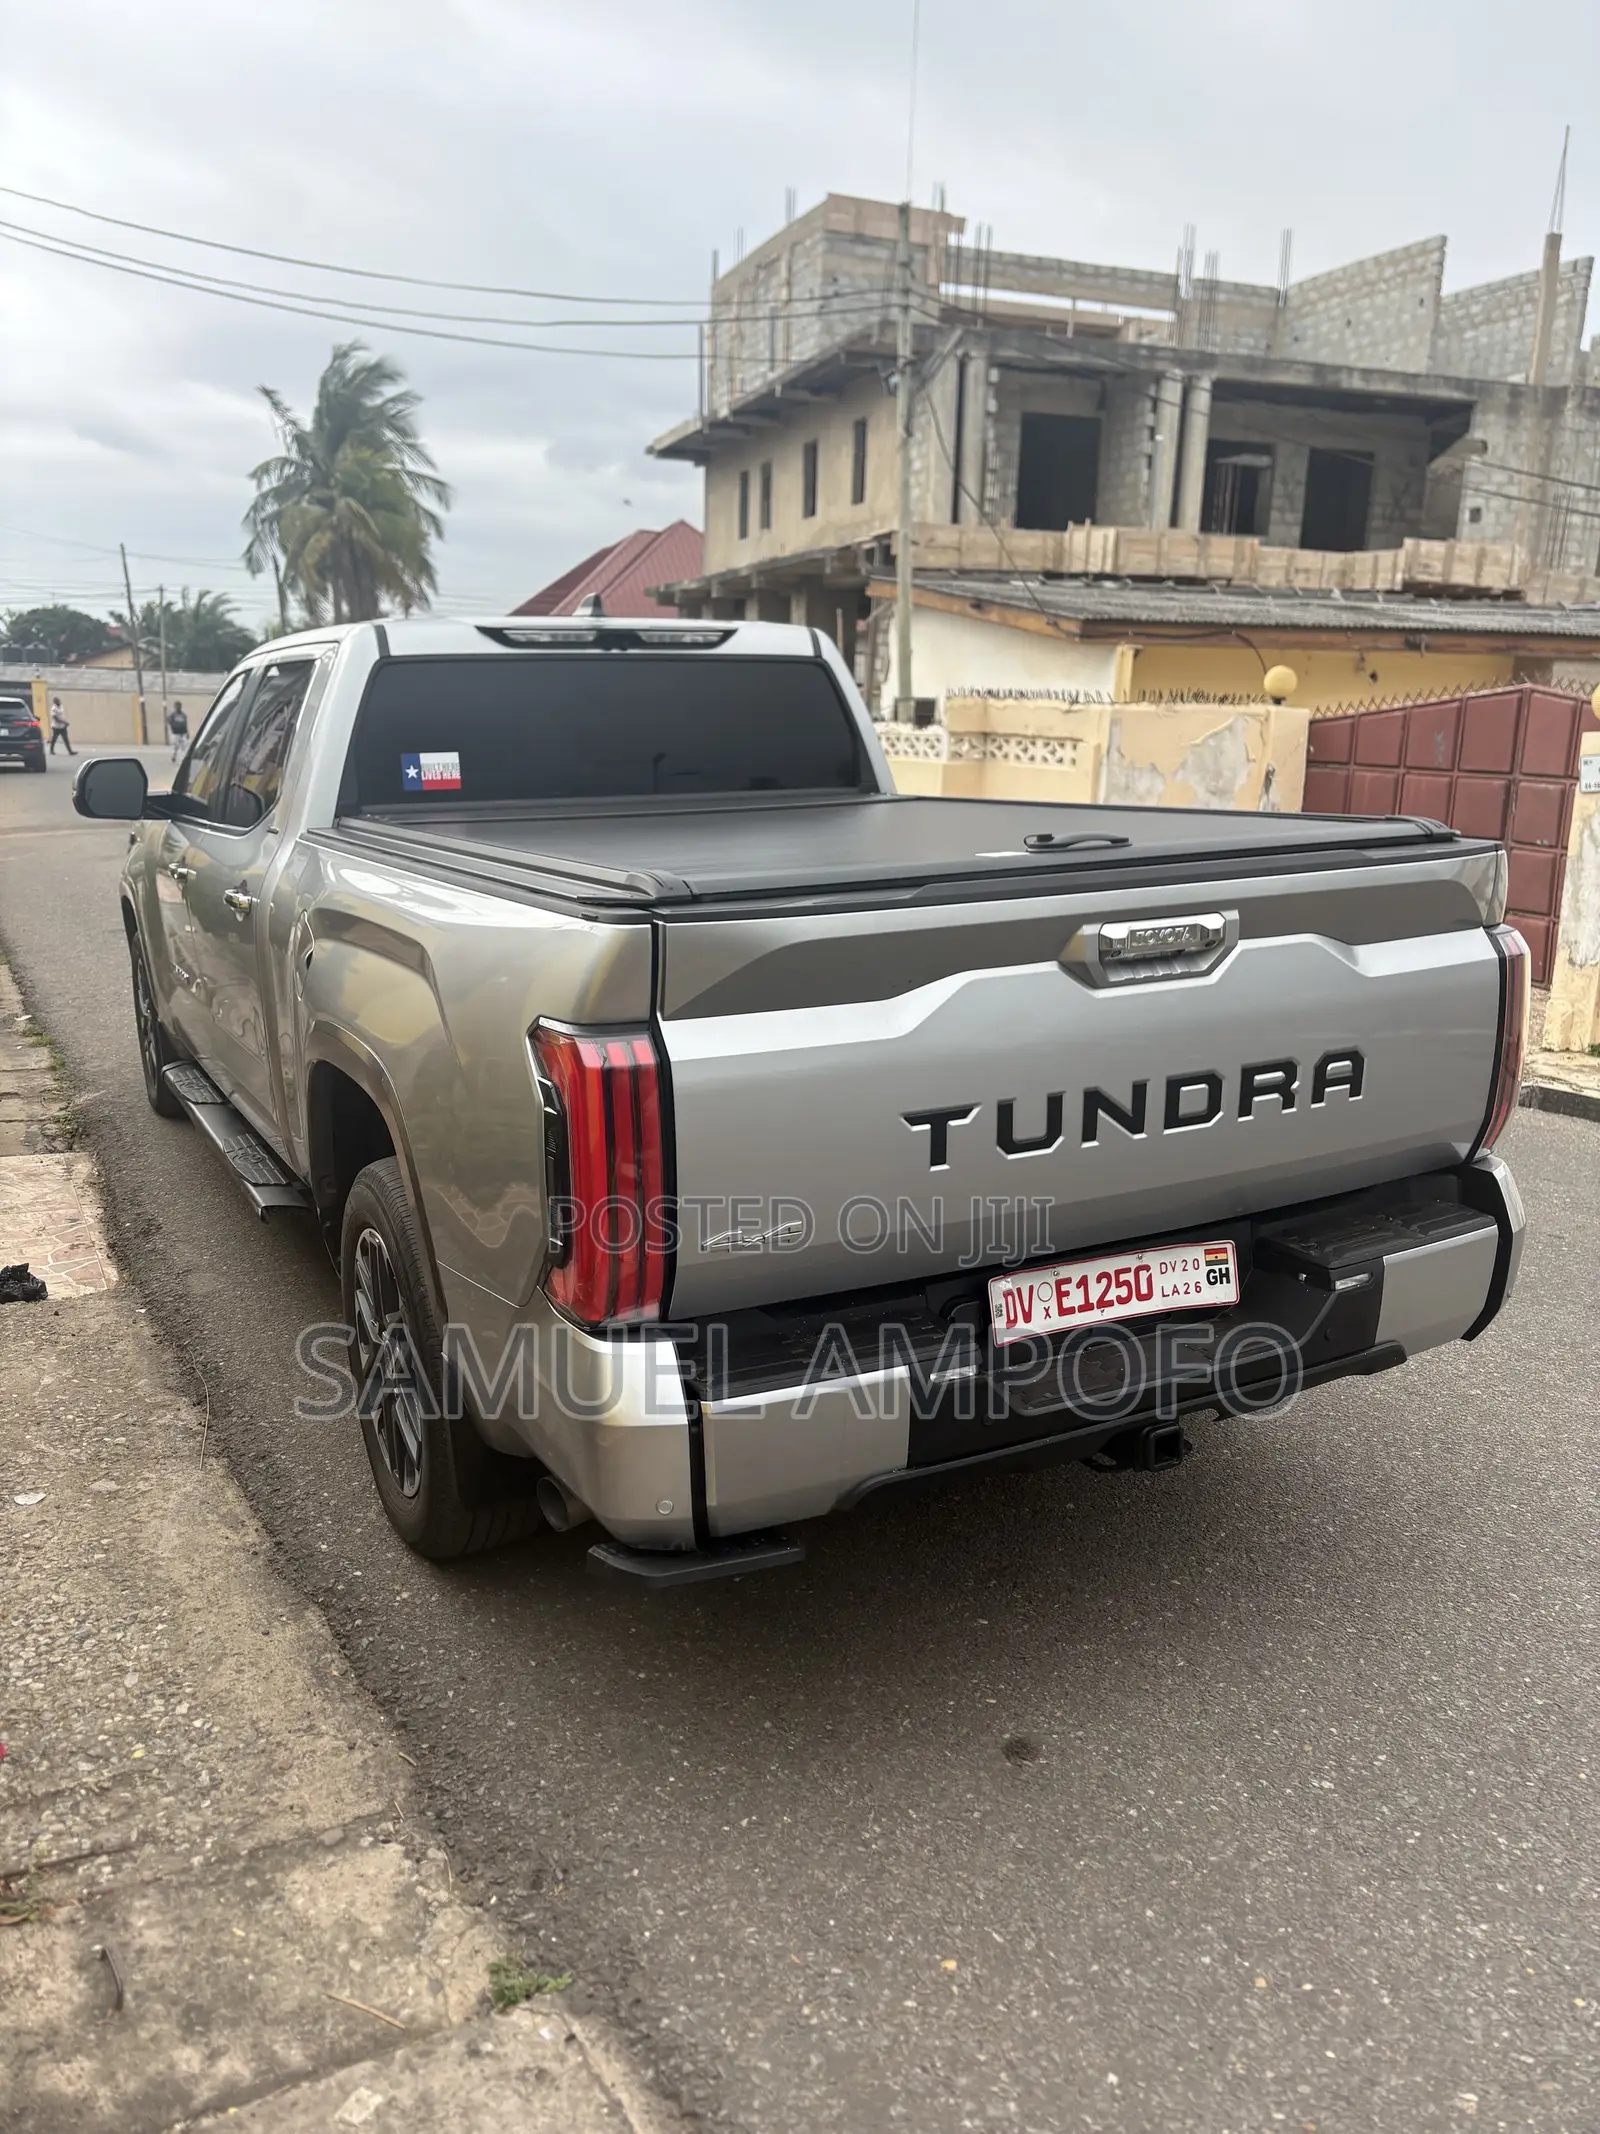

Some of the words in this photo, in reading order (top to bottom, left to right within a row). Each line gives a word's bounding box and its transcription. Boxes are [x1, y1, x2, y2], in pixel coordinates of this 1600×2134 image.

[1133, 925, 1195, 948] TOYOTA
[900, 1046, 1366, 1171] TUNDRA
[1002, 1284, 1034, 1329] DV
[1054, 1264, 1154, 1317] E1250
[1206, 1267, 1231, 1286] GH
